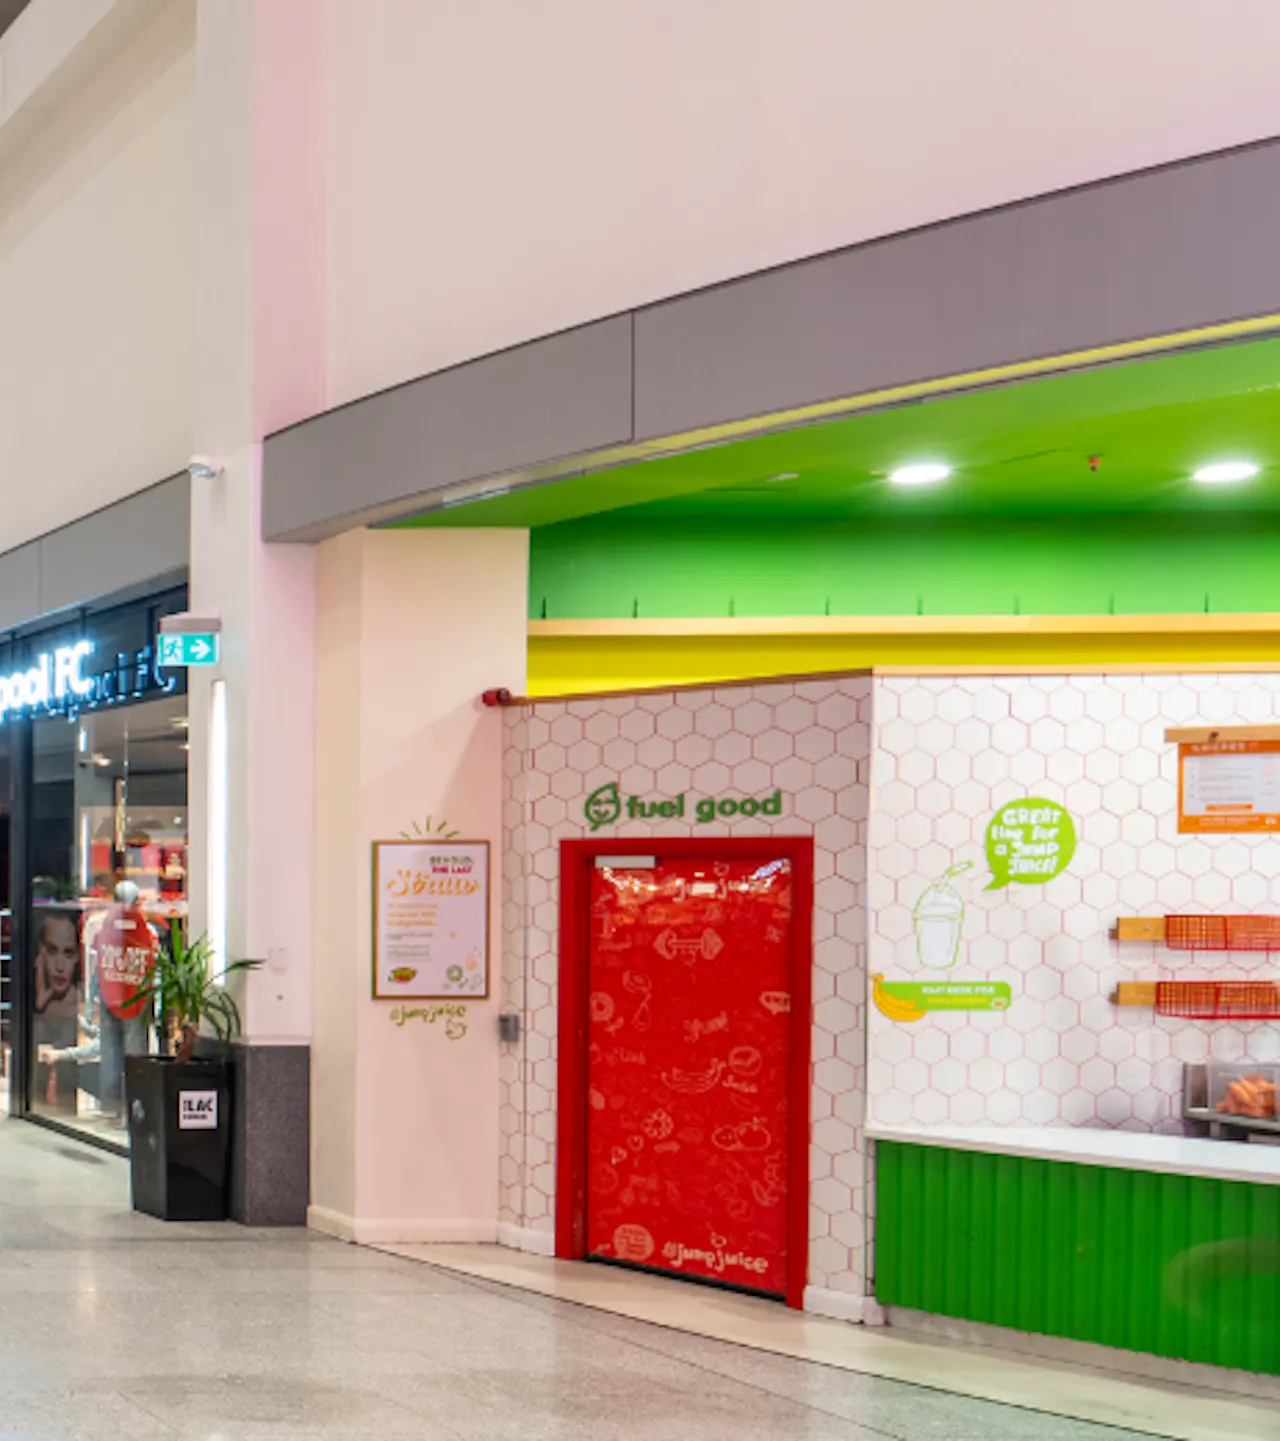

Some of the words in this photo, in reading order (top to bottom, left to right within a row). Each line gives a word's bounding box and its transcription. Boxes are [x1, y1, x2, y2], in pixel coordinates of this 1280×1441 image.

[54, 641, 96, 697] FC
[626, 793, 685, 819] fuel
[696, 788, 781, 823] good
[1002, 807, 1062, 826] GREAT
